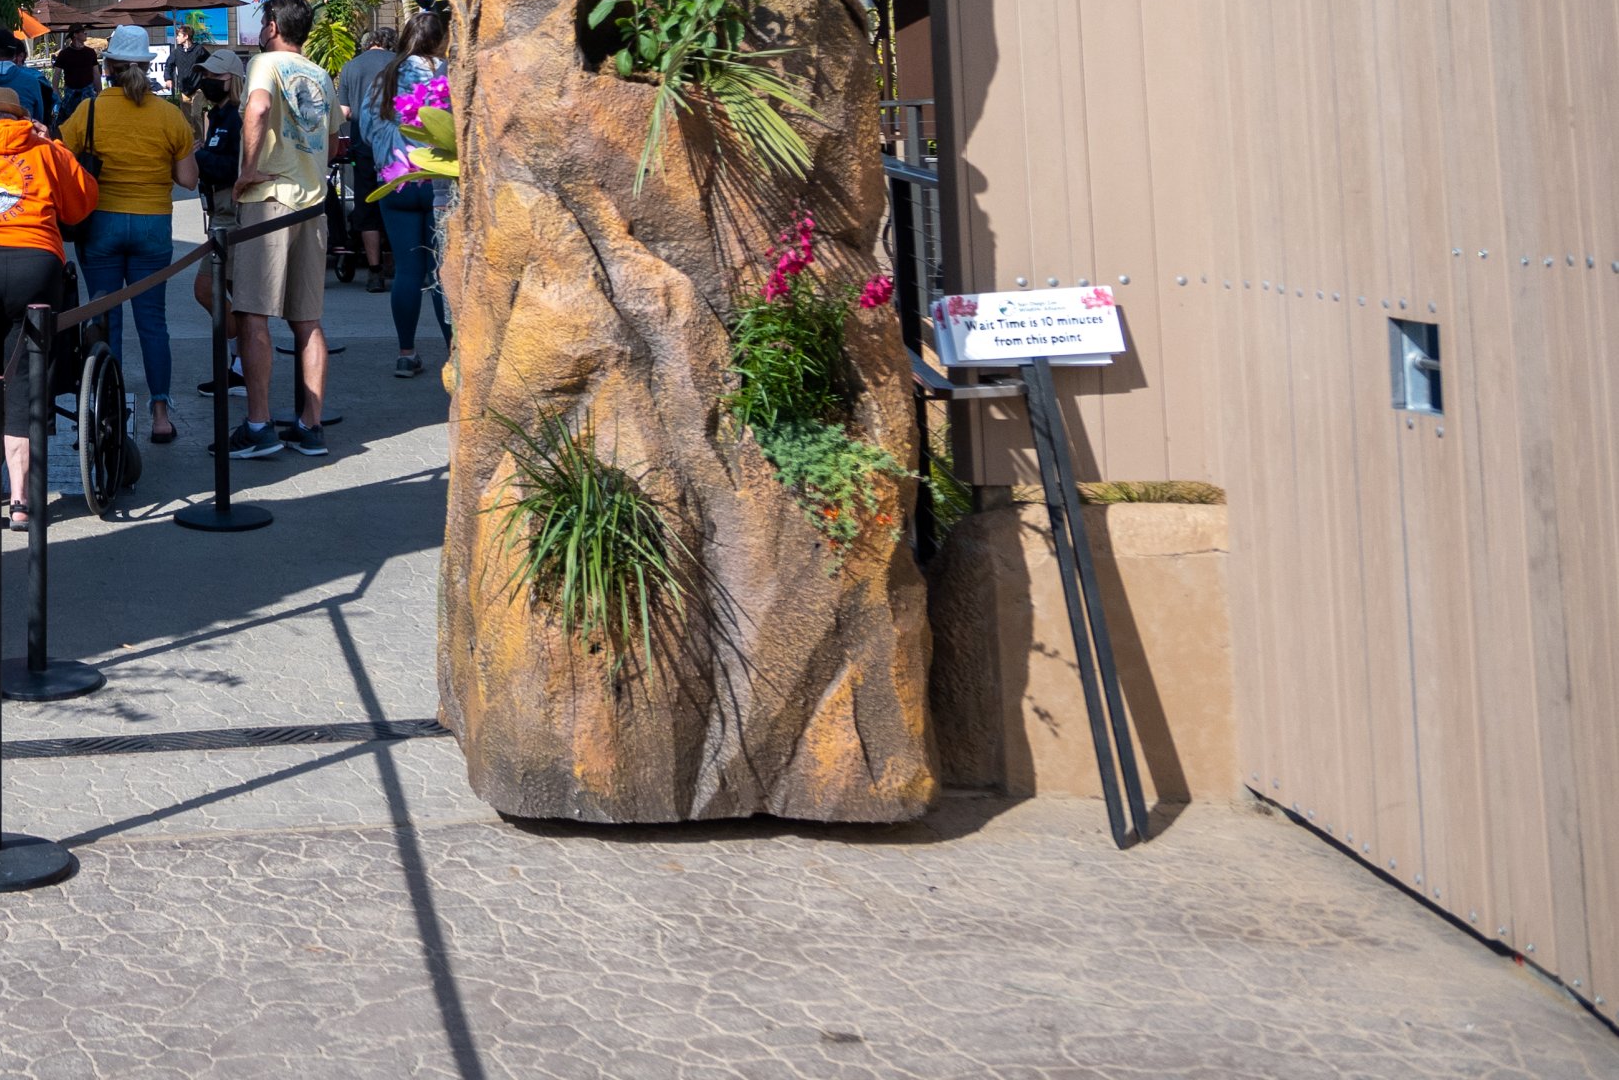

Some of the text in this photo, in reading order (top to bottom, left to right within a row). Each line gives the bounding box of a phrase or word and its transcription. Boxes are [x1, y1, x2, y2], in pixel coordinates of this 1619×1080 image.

[964, 315, 1104, 332] Wait Time is 10 minutes
[994, 332, 1083, 346] from this point
